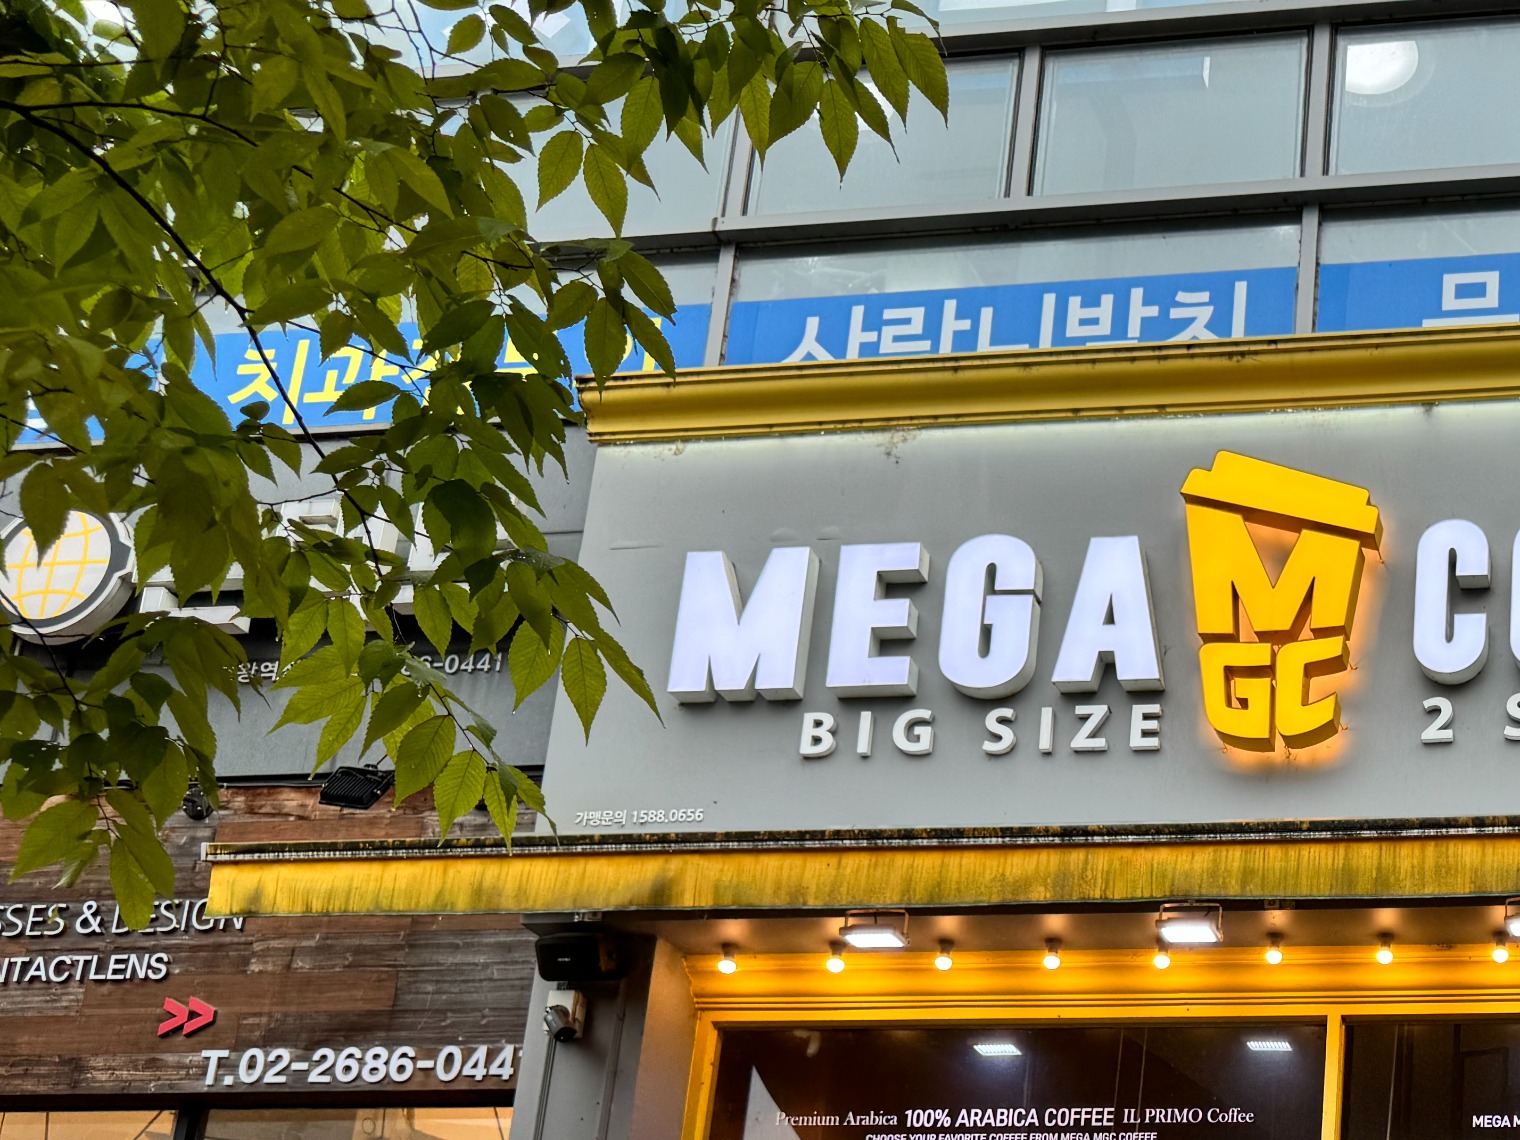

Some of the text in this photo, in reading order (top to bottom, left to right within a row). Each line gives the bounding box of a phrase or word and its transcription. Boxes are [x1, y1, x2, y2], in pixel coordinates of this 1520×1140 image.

[667, 534, 1166, 702] MEGA
[799, 709, 935, 757] BIG
[981, 703, 1163, 755] SIZE
[1421, 697, 1454, 743] 2
[574, 808, 704, 827] 가맹문의 1588.0656
[75, 900, 105, 934] &
[201, 1045, 523, 1087] T.02-2686-044
[775, 1107, 1254, 1128] Premium Arabica 100% ARABICA COFFEE IL PRIMO Coffee
[1472, 1115, 1511, 1128] MEGA
